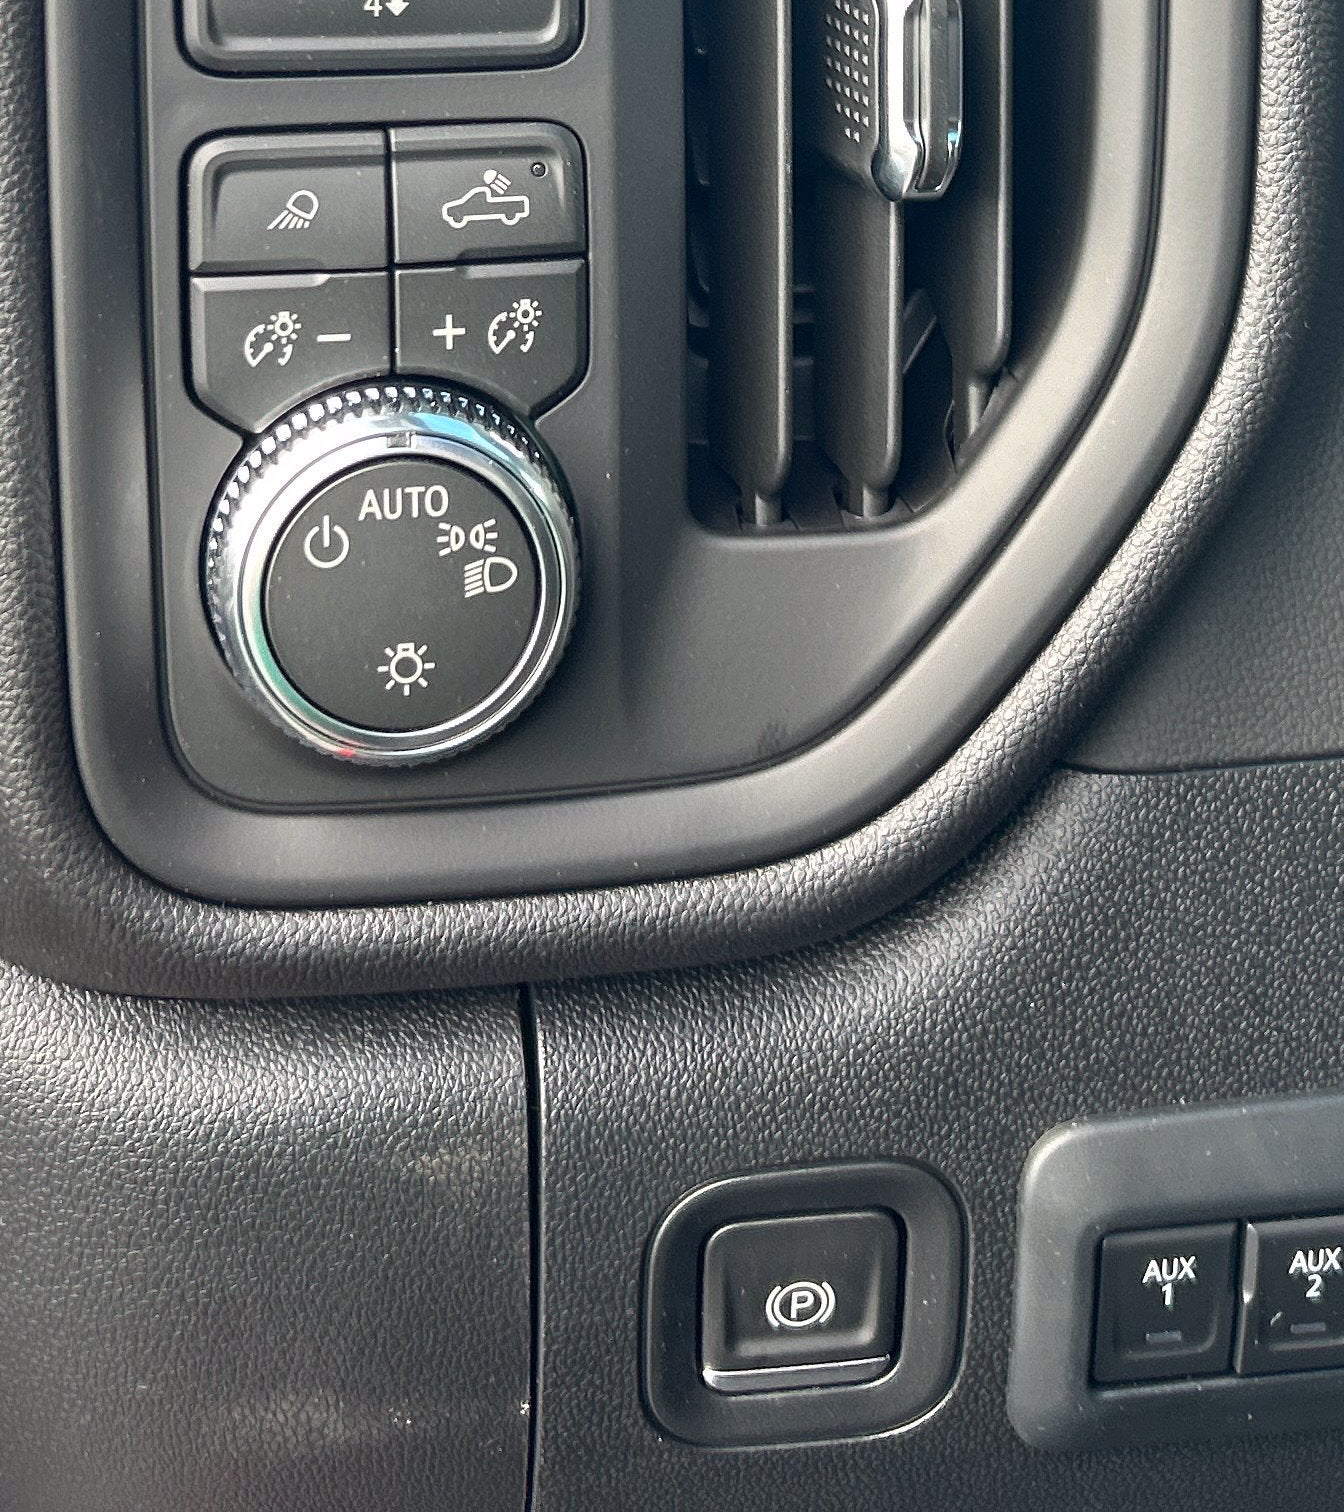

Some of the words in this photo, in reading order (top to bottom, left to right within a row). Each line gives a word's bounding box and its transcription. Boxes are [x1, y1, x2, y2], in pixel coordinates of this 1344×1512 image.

[357, 484, 450, 522] AUTO
[1141, 1254, 1197, 1285] AUX
[1287, 1245, 1343, 1276] AUX
[1160, 1282, 1174, 1307] 1
[1304, 1273, 1324, 1299] 2
